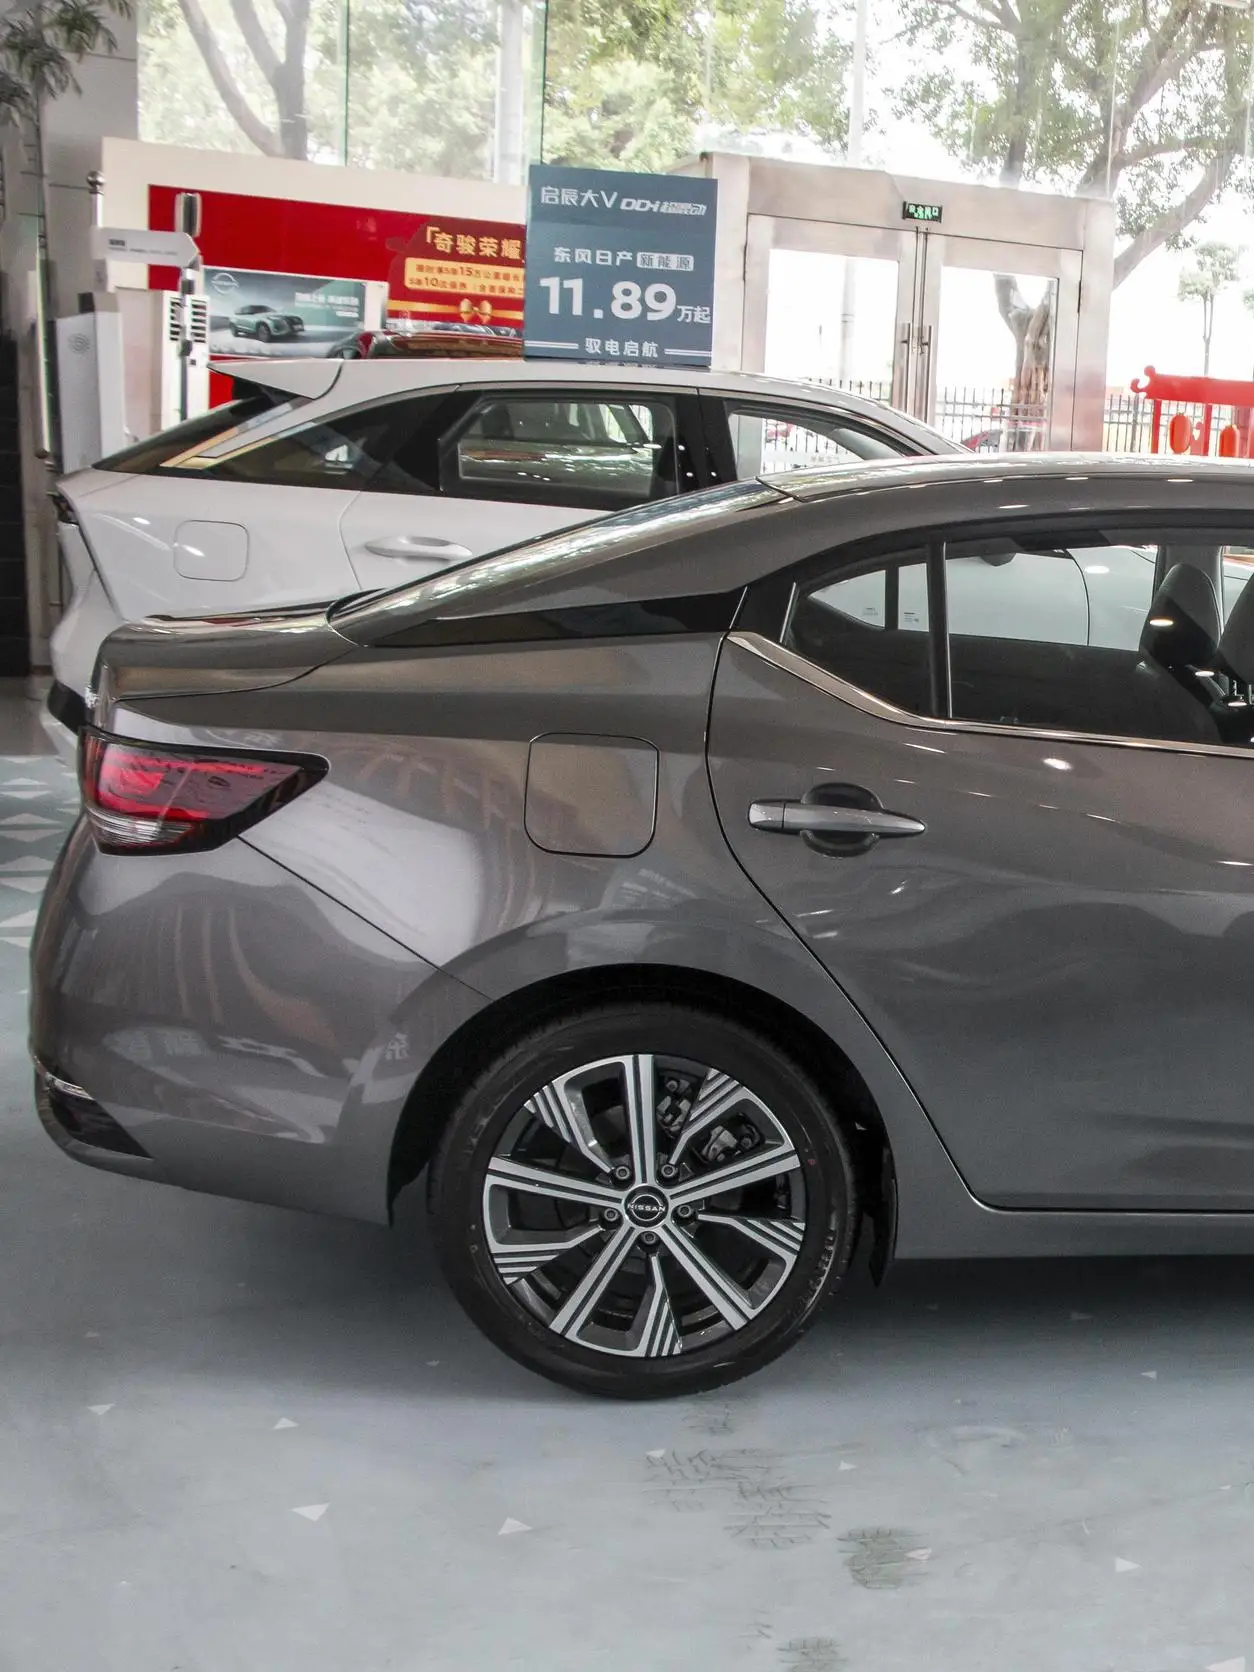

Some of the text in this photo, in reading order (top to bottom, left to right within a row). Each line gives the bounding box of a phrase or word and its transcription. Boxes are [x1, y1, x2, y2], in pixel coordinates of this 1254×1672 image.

[541, 186, 618, 208] 启辰大V
[426, 226, 524, 263] 「奇骏荣耀
[554, 247, 693, 271] 东风日产 新能源
[585, 337, 659, 358] 驭电启航
[627, 1203, 666, 1213] NISSAN
